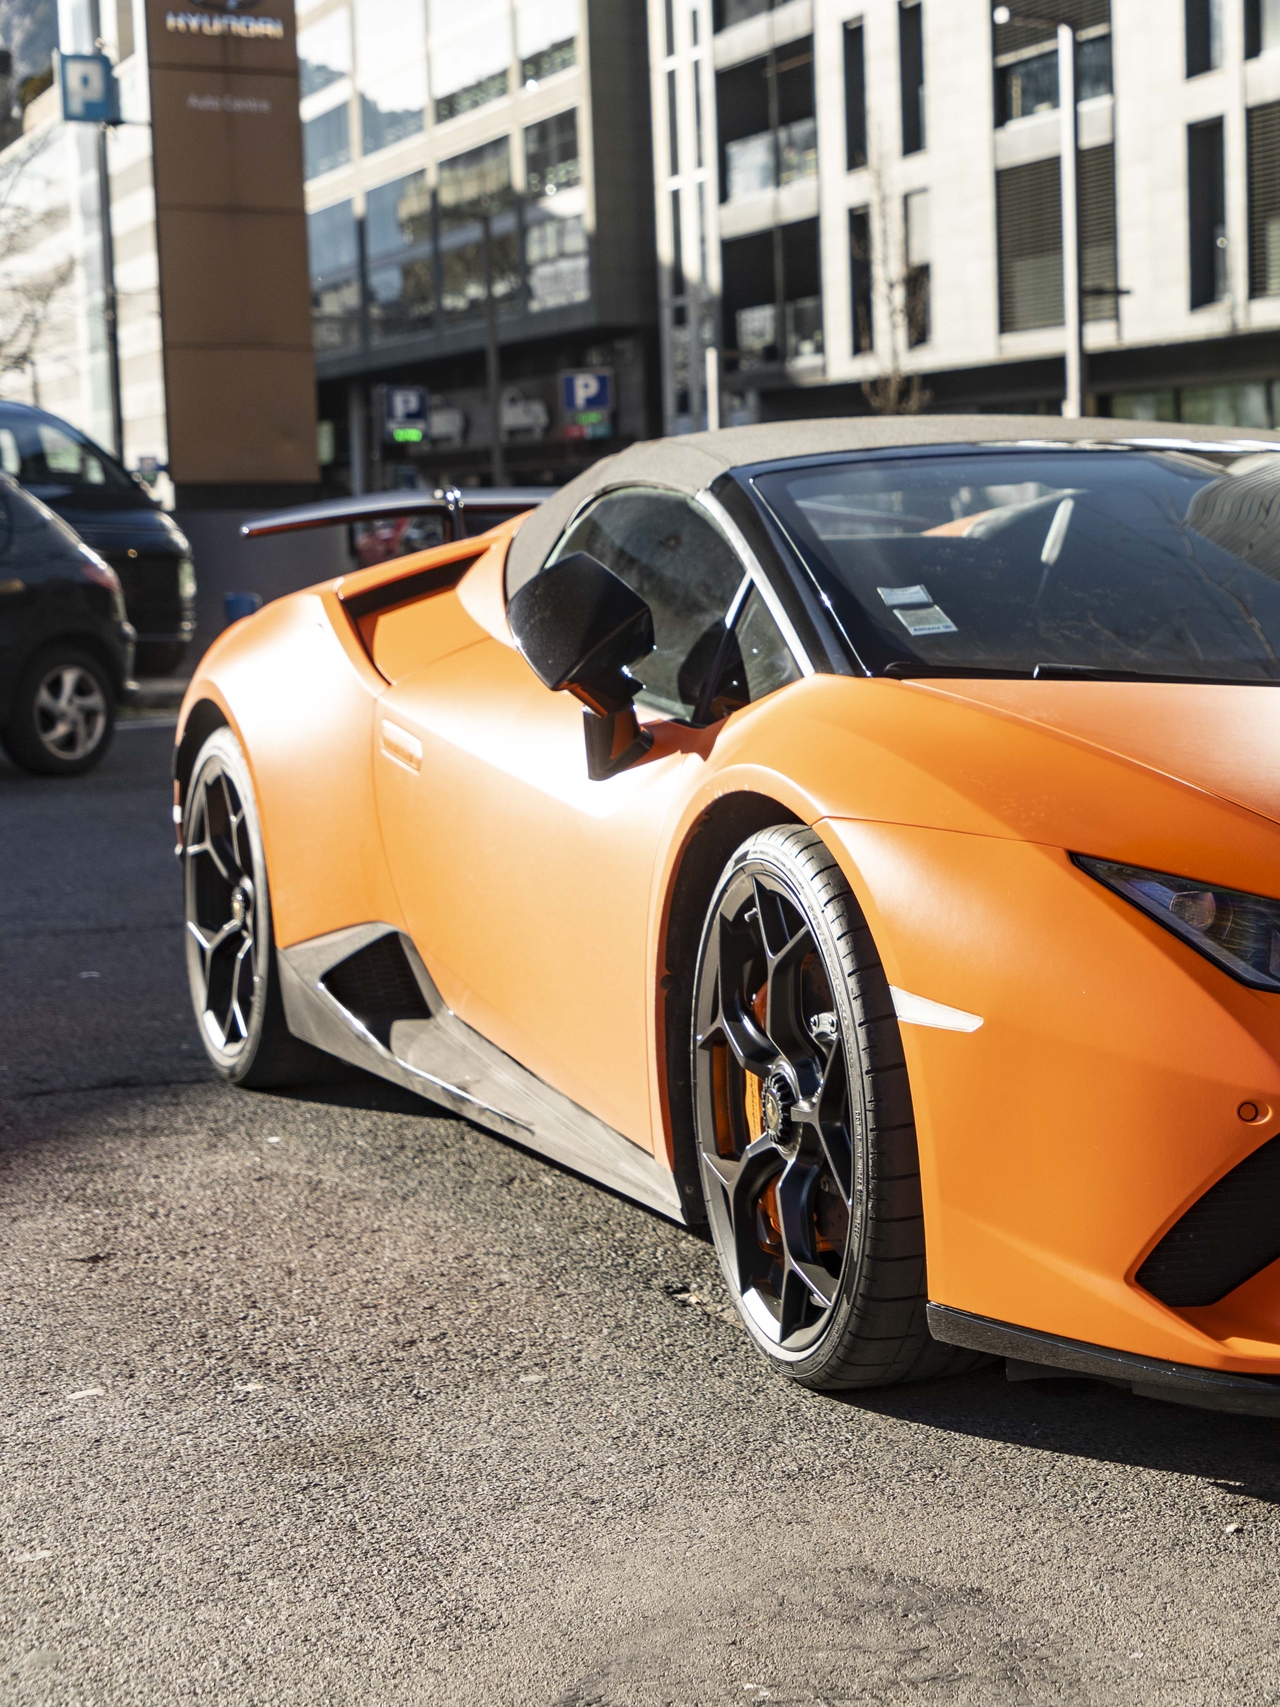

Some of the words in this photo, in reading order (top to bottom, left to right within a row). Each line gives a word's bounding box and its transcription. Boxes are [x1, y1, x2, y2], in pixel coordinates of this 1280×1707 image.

[166, 11, 284, 39] HYUNDAI
[66, 60, 104, 115] P
[393, 389, 420, 419] P
[573, 374, 599, 409] P
